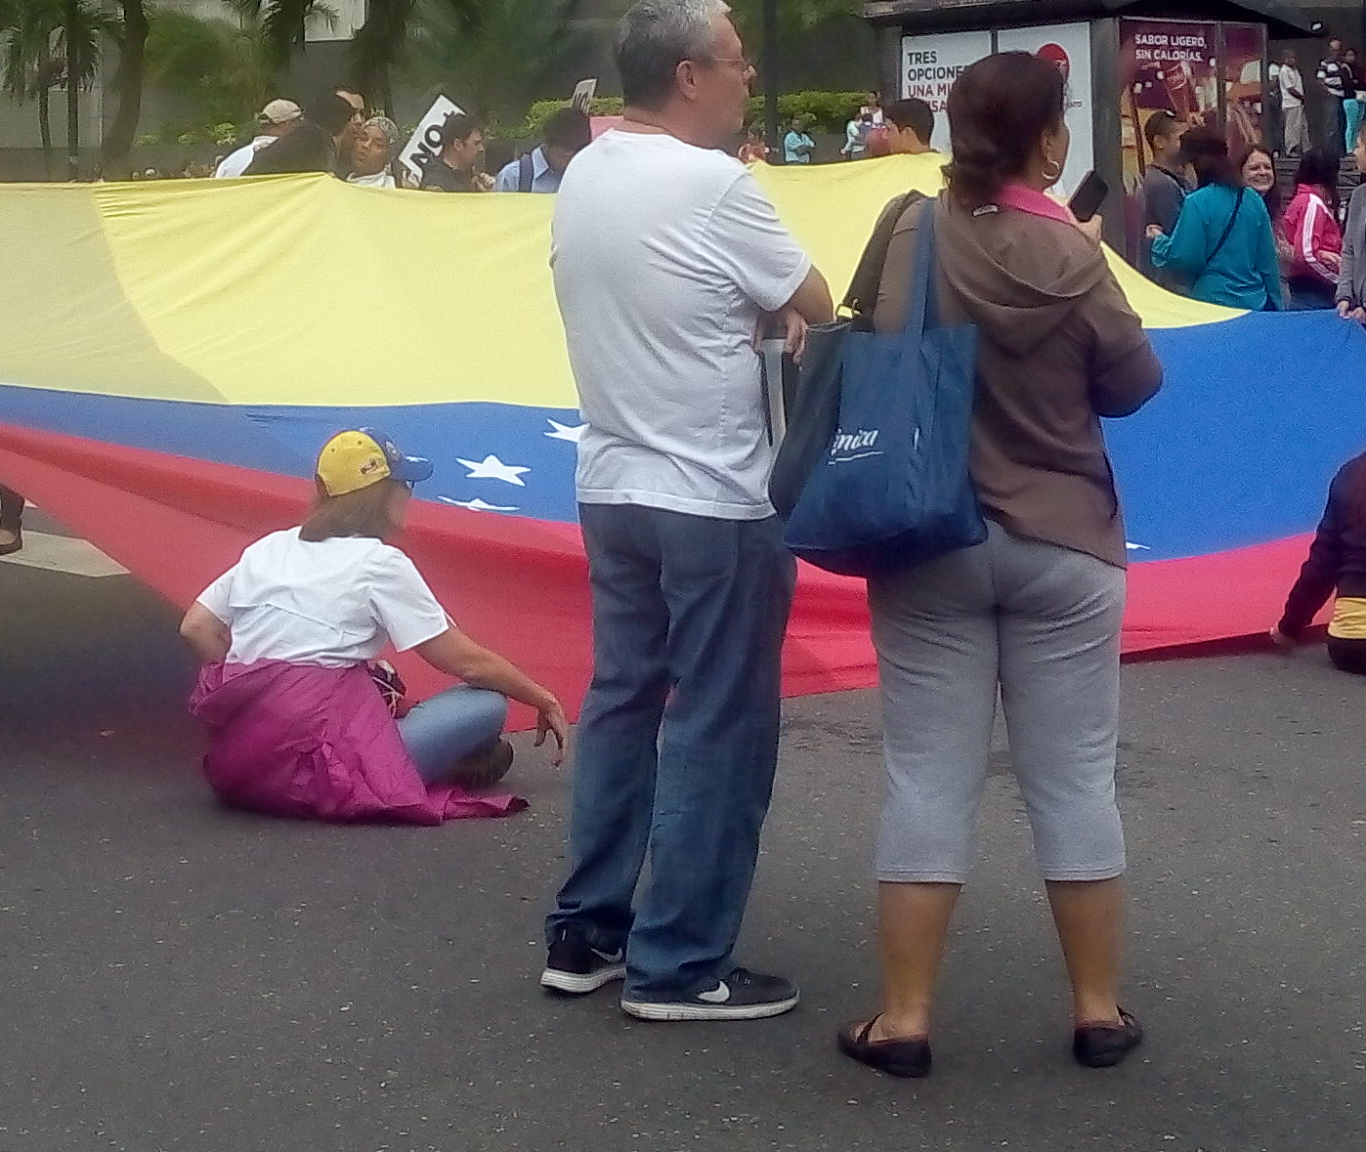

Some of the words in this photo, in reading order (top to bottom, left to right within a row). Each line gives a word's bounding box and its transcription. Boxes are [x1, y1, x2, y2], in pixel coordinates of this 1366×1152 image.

[1135, 34, 1168, 46] SABOR
[1171, 36, 1207, 49] LIGERO,
[907, 51, 937, 65] TRES
[1135, 49, 1152, 60] SIN
[907, 65, 966, 81] OPCIONE
[907, 84, 935, 98] UNA
